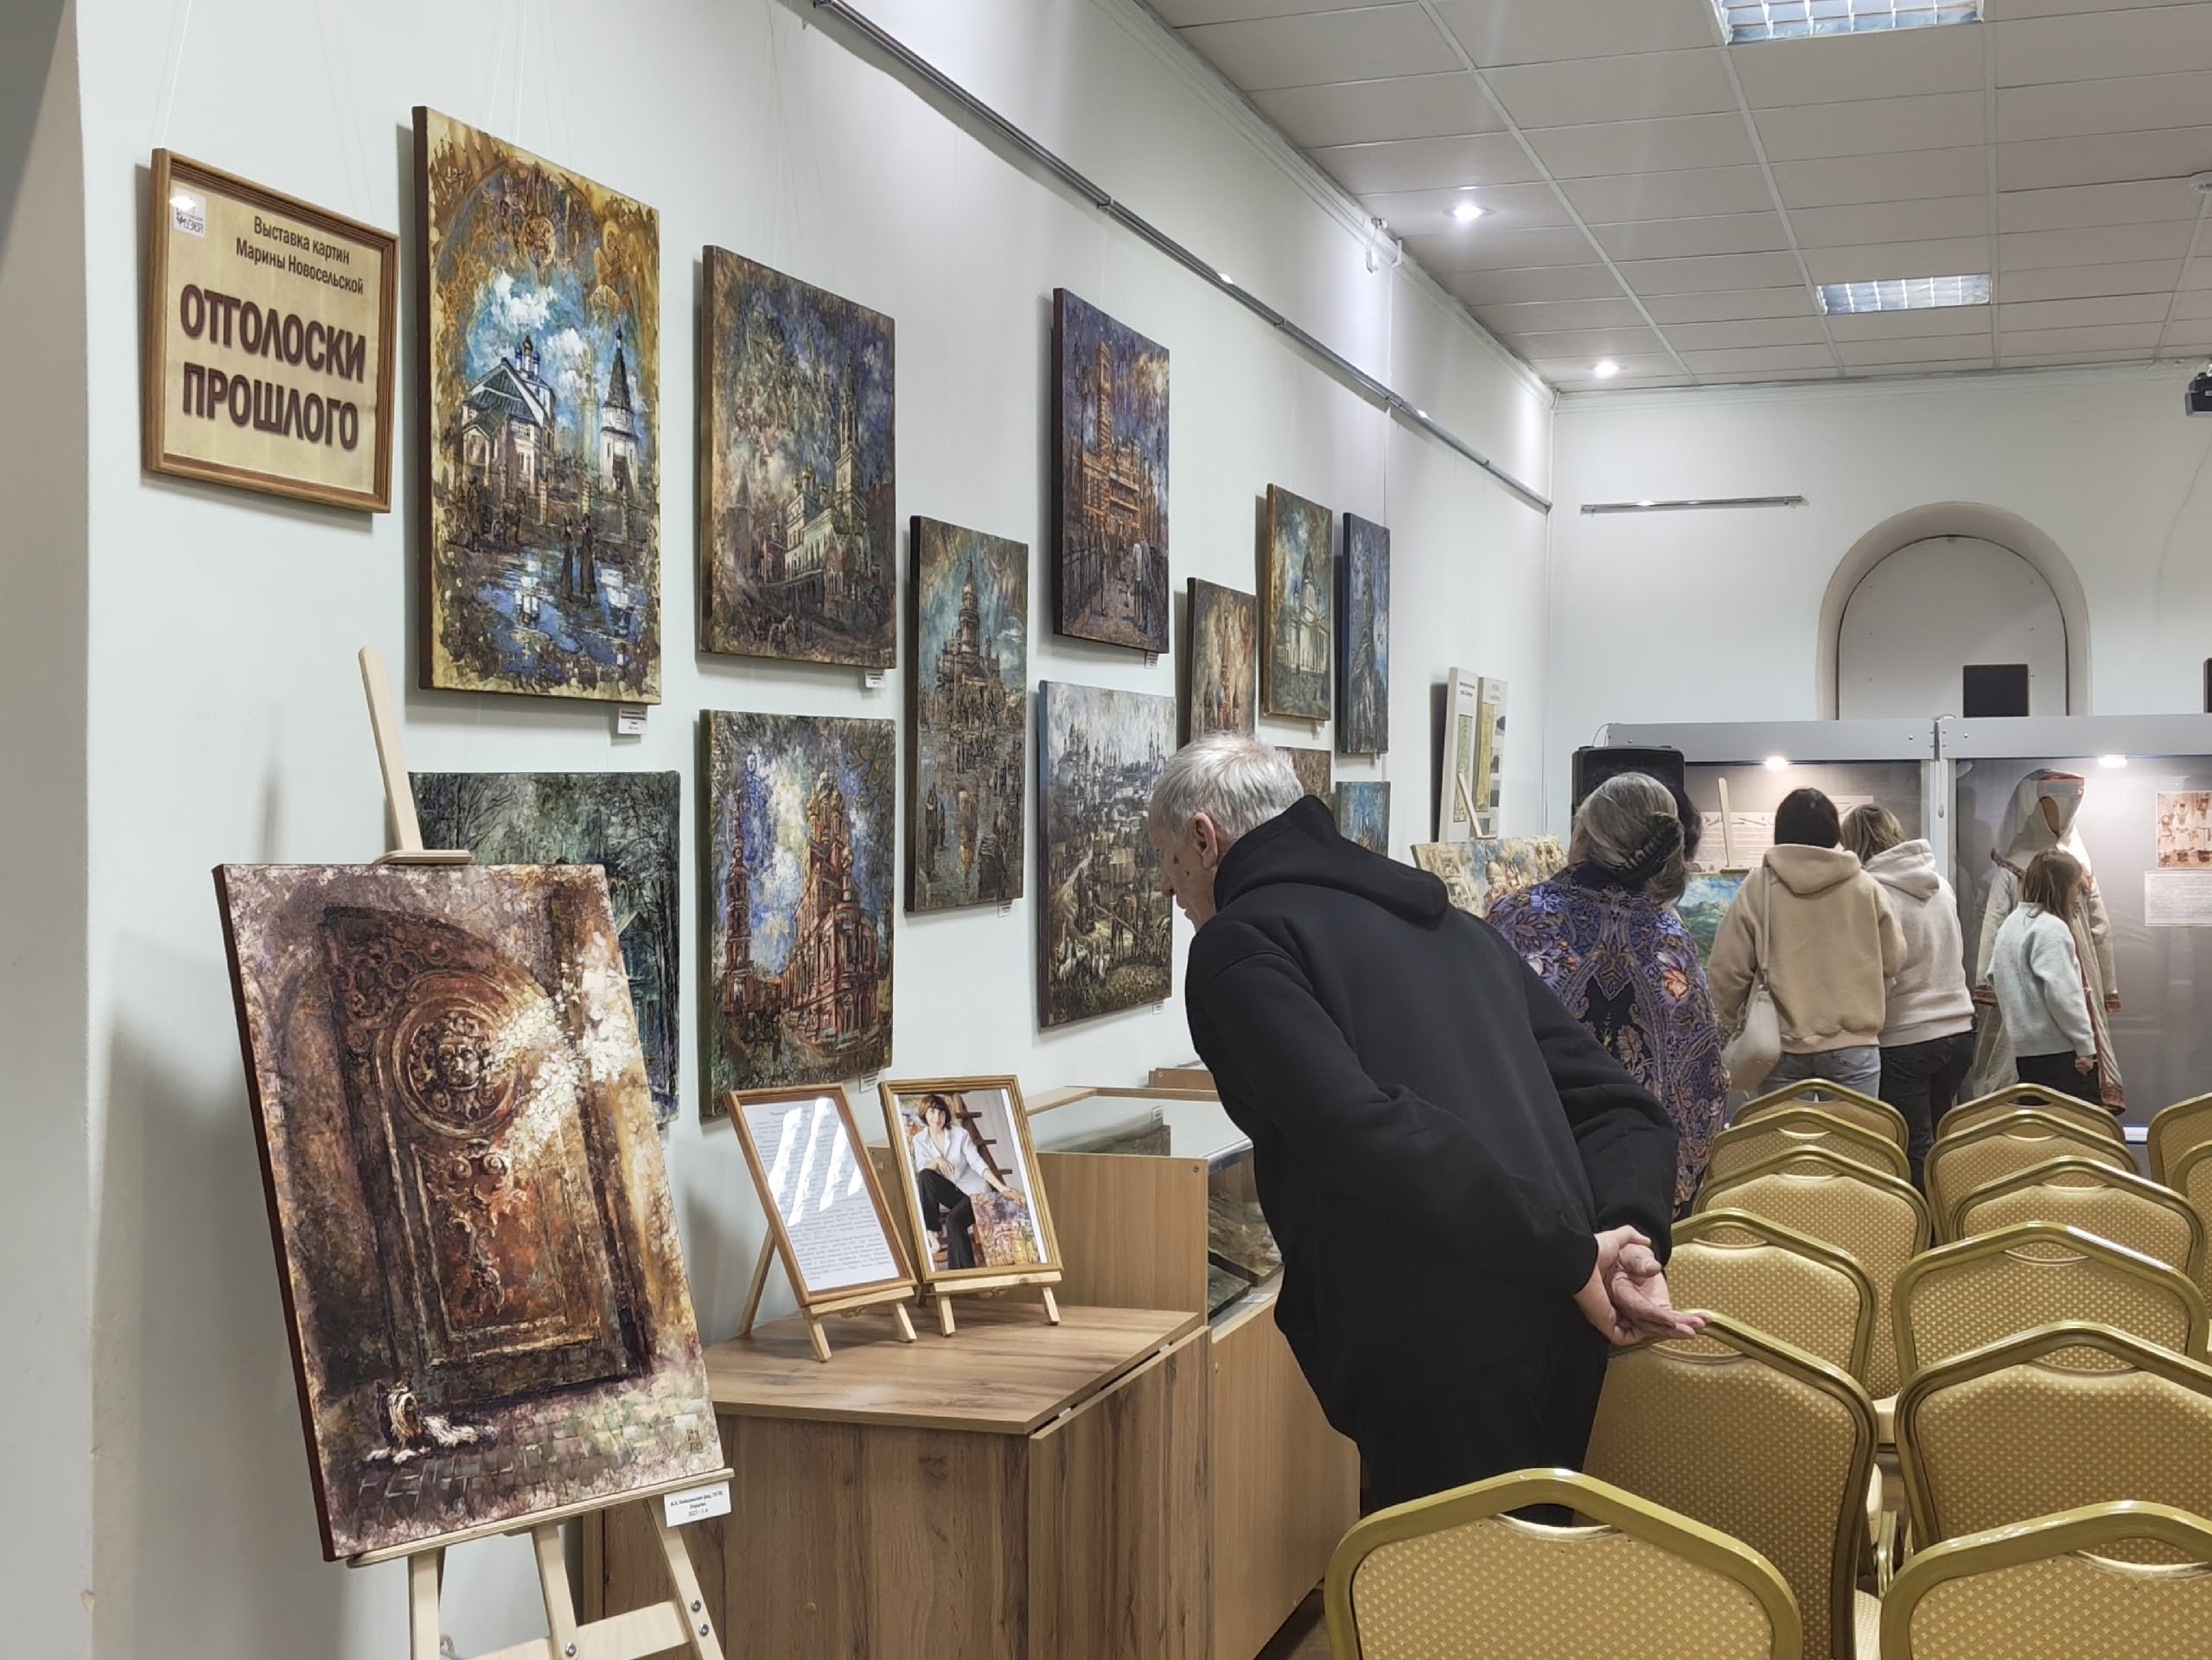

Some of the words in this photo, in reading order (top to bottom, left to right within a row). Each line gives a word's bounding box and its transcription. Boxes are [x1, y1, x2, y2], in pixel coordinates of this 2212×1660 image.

[236, 237, 286, 270] Марины
[288, 254, 364, 295] Новосельской
[253, 215, 310, 251] Выставка
[312, 239, 350, 265] картин
[180, 284, 367, 383] ОТГОЛОСКИ
[182, 361, 359, 451] ПРОШЛОГО
